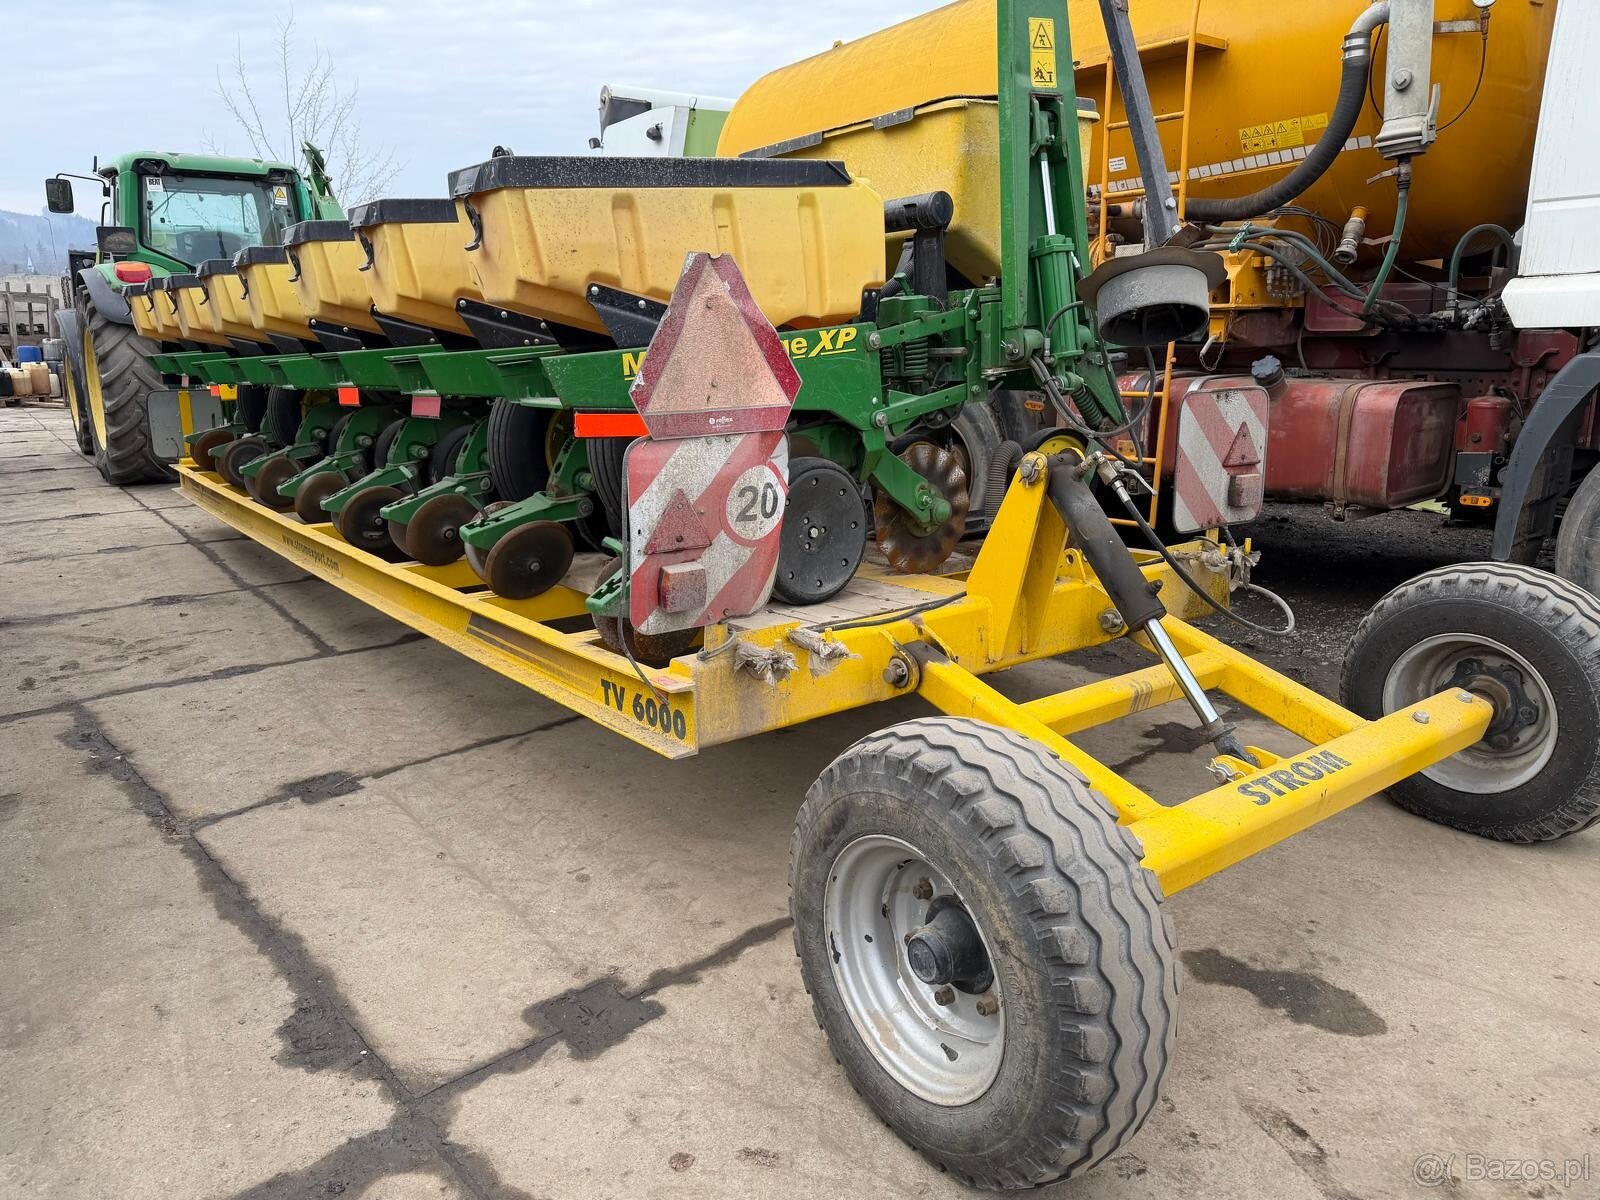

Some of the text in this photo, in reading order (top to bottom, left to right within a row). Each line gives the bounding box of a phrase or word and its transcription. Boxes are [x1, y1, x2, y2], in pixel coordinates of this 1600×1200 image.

[808, 327, 857, 357] XP
[734, 481, 779, 522] 20
[600, 678, 687, 741] TV 6000
[1237, 750, 1353, 806] STROM
